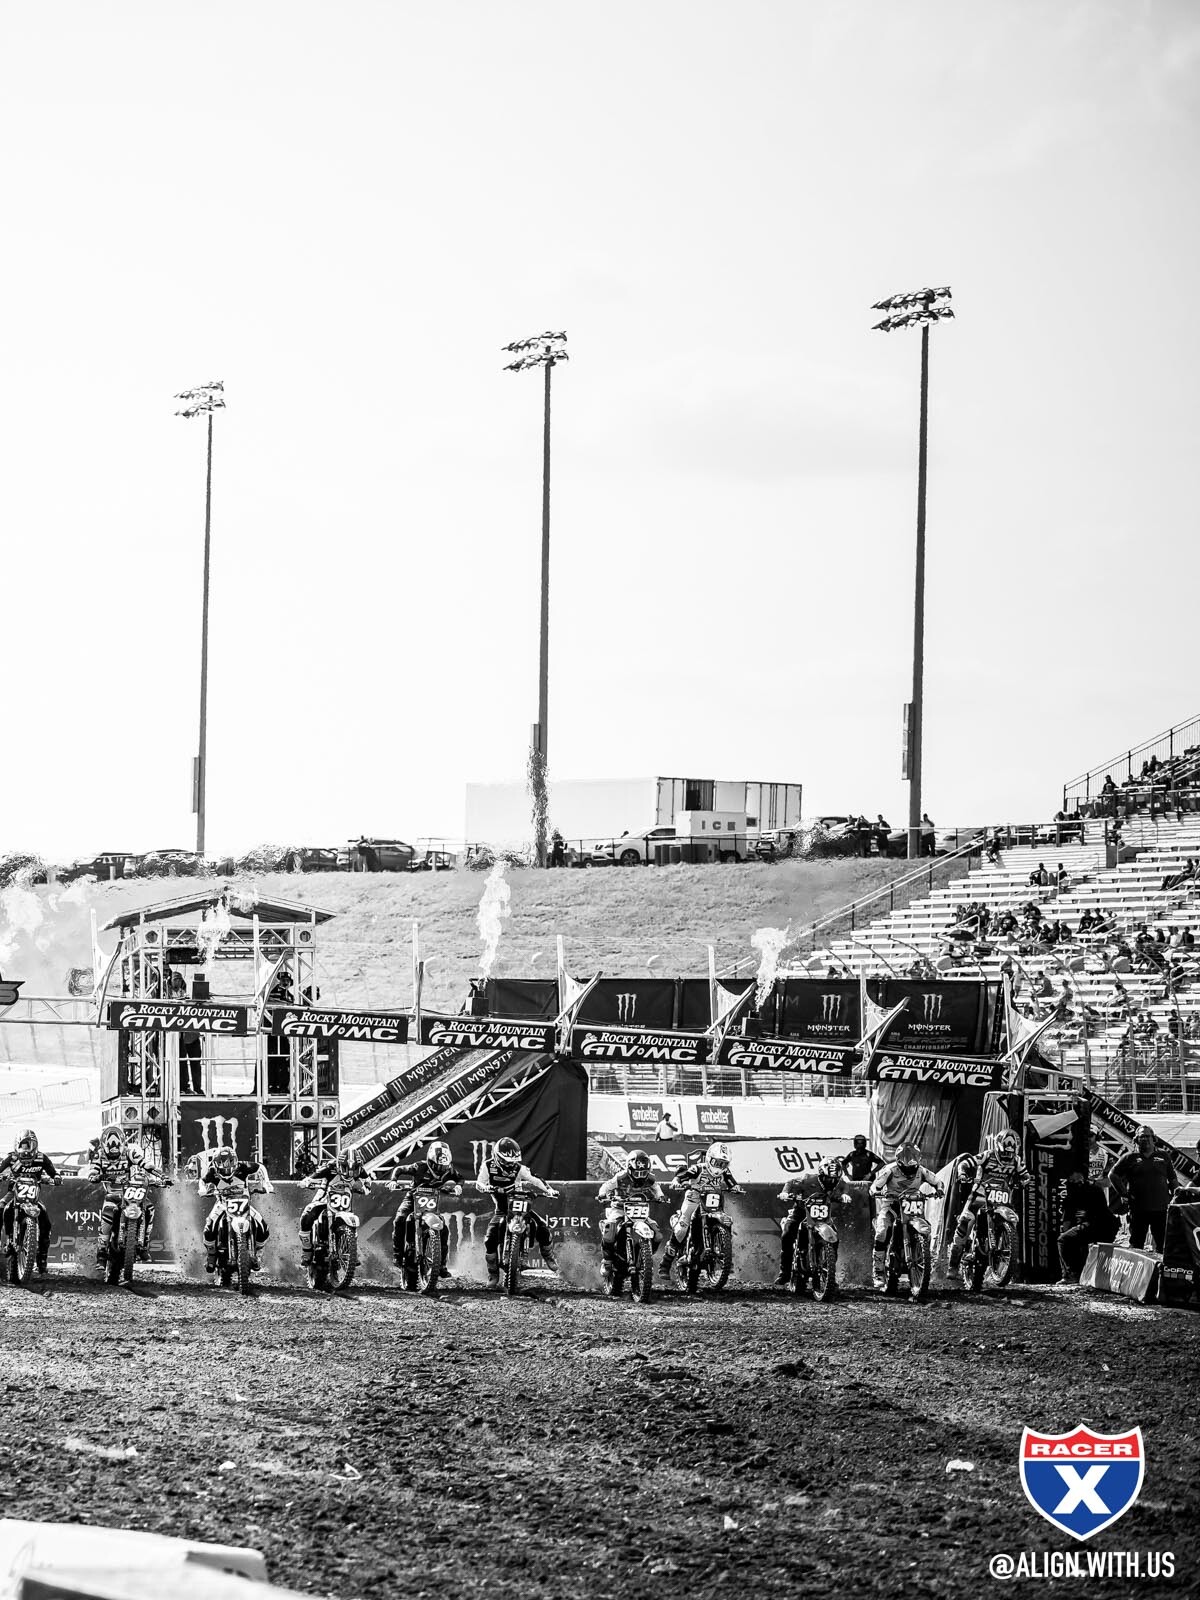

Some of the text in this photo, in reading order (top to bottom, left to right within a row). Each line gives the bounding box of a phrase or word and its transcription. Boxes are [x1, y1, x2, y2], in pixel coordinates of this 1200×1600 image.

[701, 820, 736, 831] ICE
[138, 1004, 238, 1018] ROCKY MOUNTAIN
[300, 1011, 400, 1027] ROCKY MOUNTAIN
[447, 1022, 547, 1036] ROCKY MOUNTAIN
[807, 1024, 851, 1032] MONSTER
[908, 1024, 951, 1032] MONSTER
[600, 1032, 699, 1048] ROCKY MOUNTAIN
[747, 1042, 846, 1060] ROCKY MOUNTAIN
[896, 1056, 994, 1074] ROCKY MOUNTAIN
[631, 1105, 660, 1121] ambetter
[700, 1108, 730, 1124] ambetter
[380, 1104, 438, 1144] MONSTER
[21, 1165, 43, 1174] THOR
[17, 1184, 38, 1199] 29
[123, 1186, 147, 1200] 66
[988, 1190, 1009, 1204] 460
[227, 1199, 249, 1213] 57
[330, 1194, 350, 1208] 30
[417, 1196, 437, 1209] 96
[511, 1200, 528, 1212] 91
[706, 1193, 720, 1207] 6
[626, 1206, 650, 1218] 339
[809, 1204, 829, 1218] 63
[901, 1200, 924, 1215] 243
[1028, 1174, 1036, 1243] CHAMPIONSHIP
[1038, 1151, 1049, 1268] SUPERCROSS
[1163, 1265, 1194, 1275] GoPro
